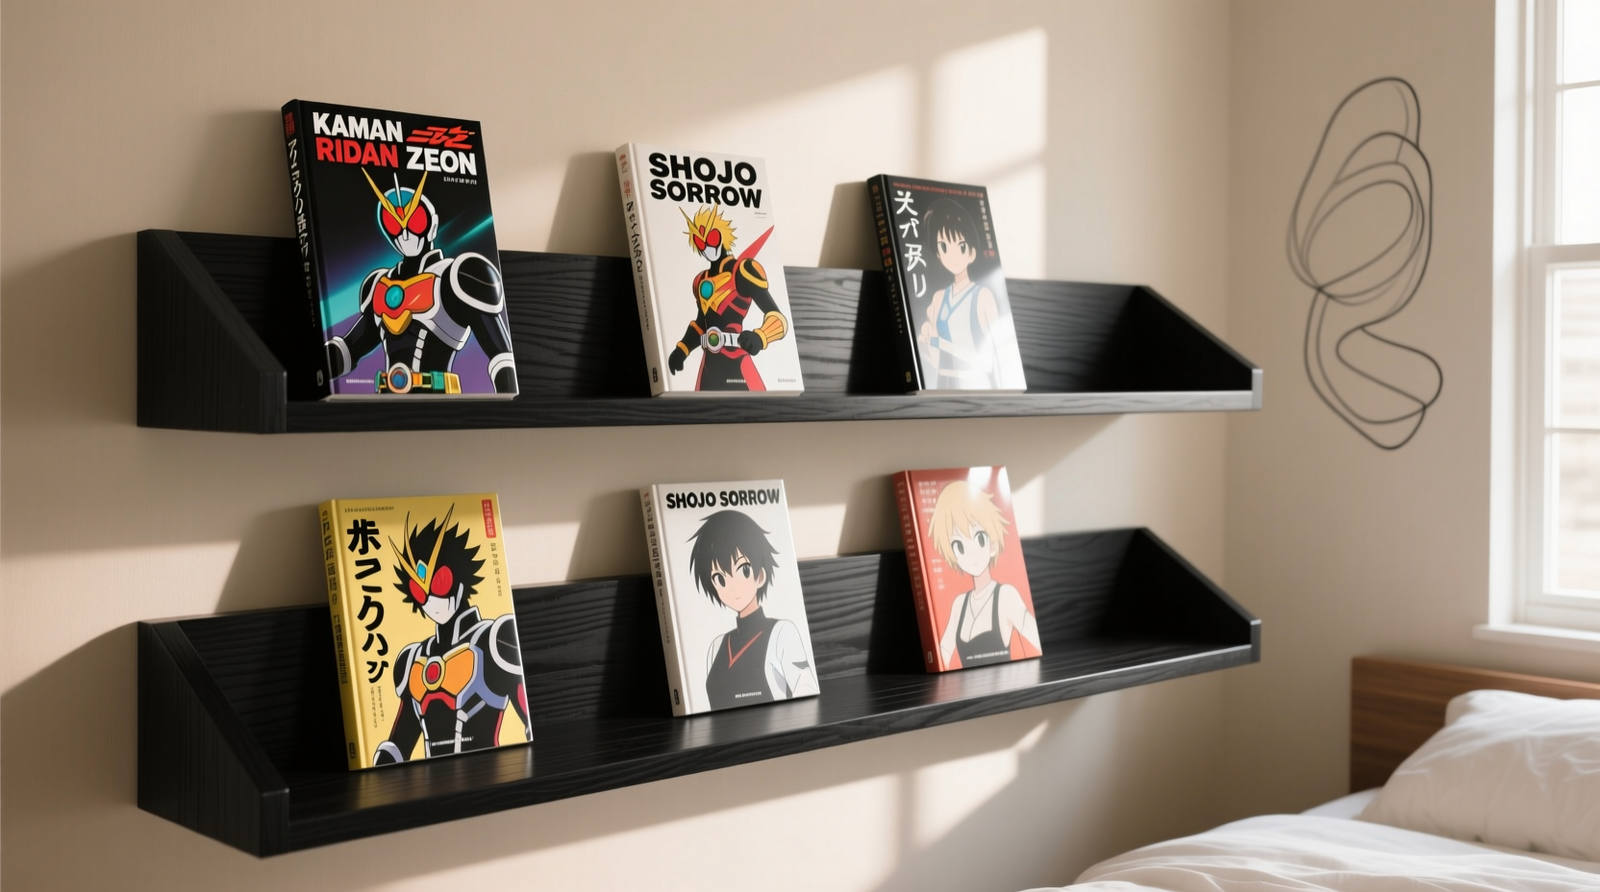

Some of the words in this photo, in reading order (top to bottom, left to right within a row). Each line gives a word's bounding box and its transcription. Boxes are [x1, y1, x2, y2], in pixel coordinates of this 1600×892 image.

[312, 111, 404, 143] KAMAN
[315, 137, 399, 168] RIDAN
[406, 145, 478, 176] ZEON
[648, 152, 757, 186] SHOJO
[650, 178, 762, 209] SORROW
[666, 491, 717, 509] SHOJO
[719, 488, 780, 507] SORROW
